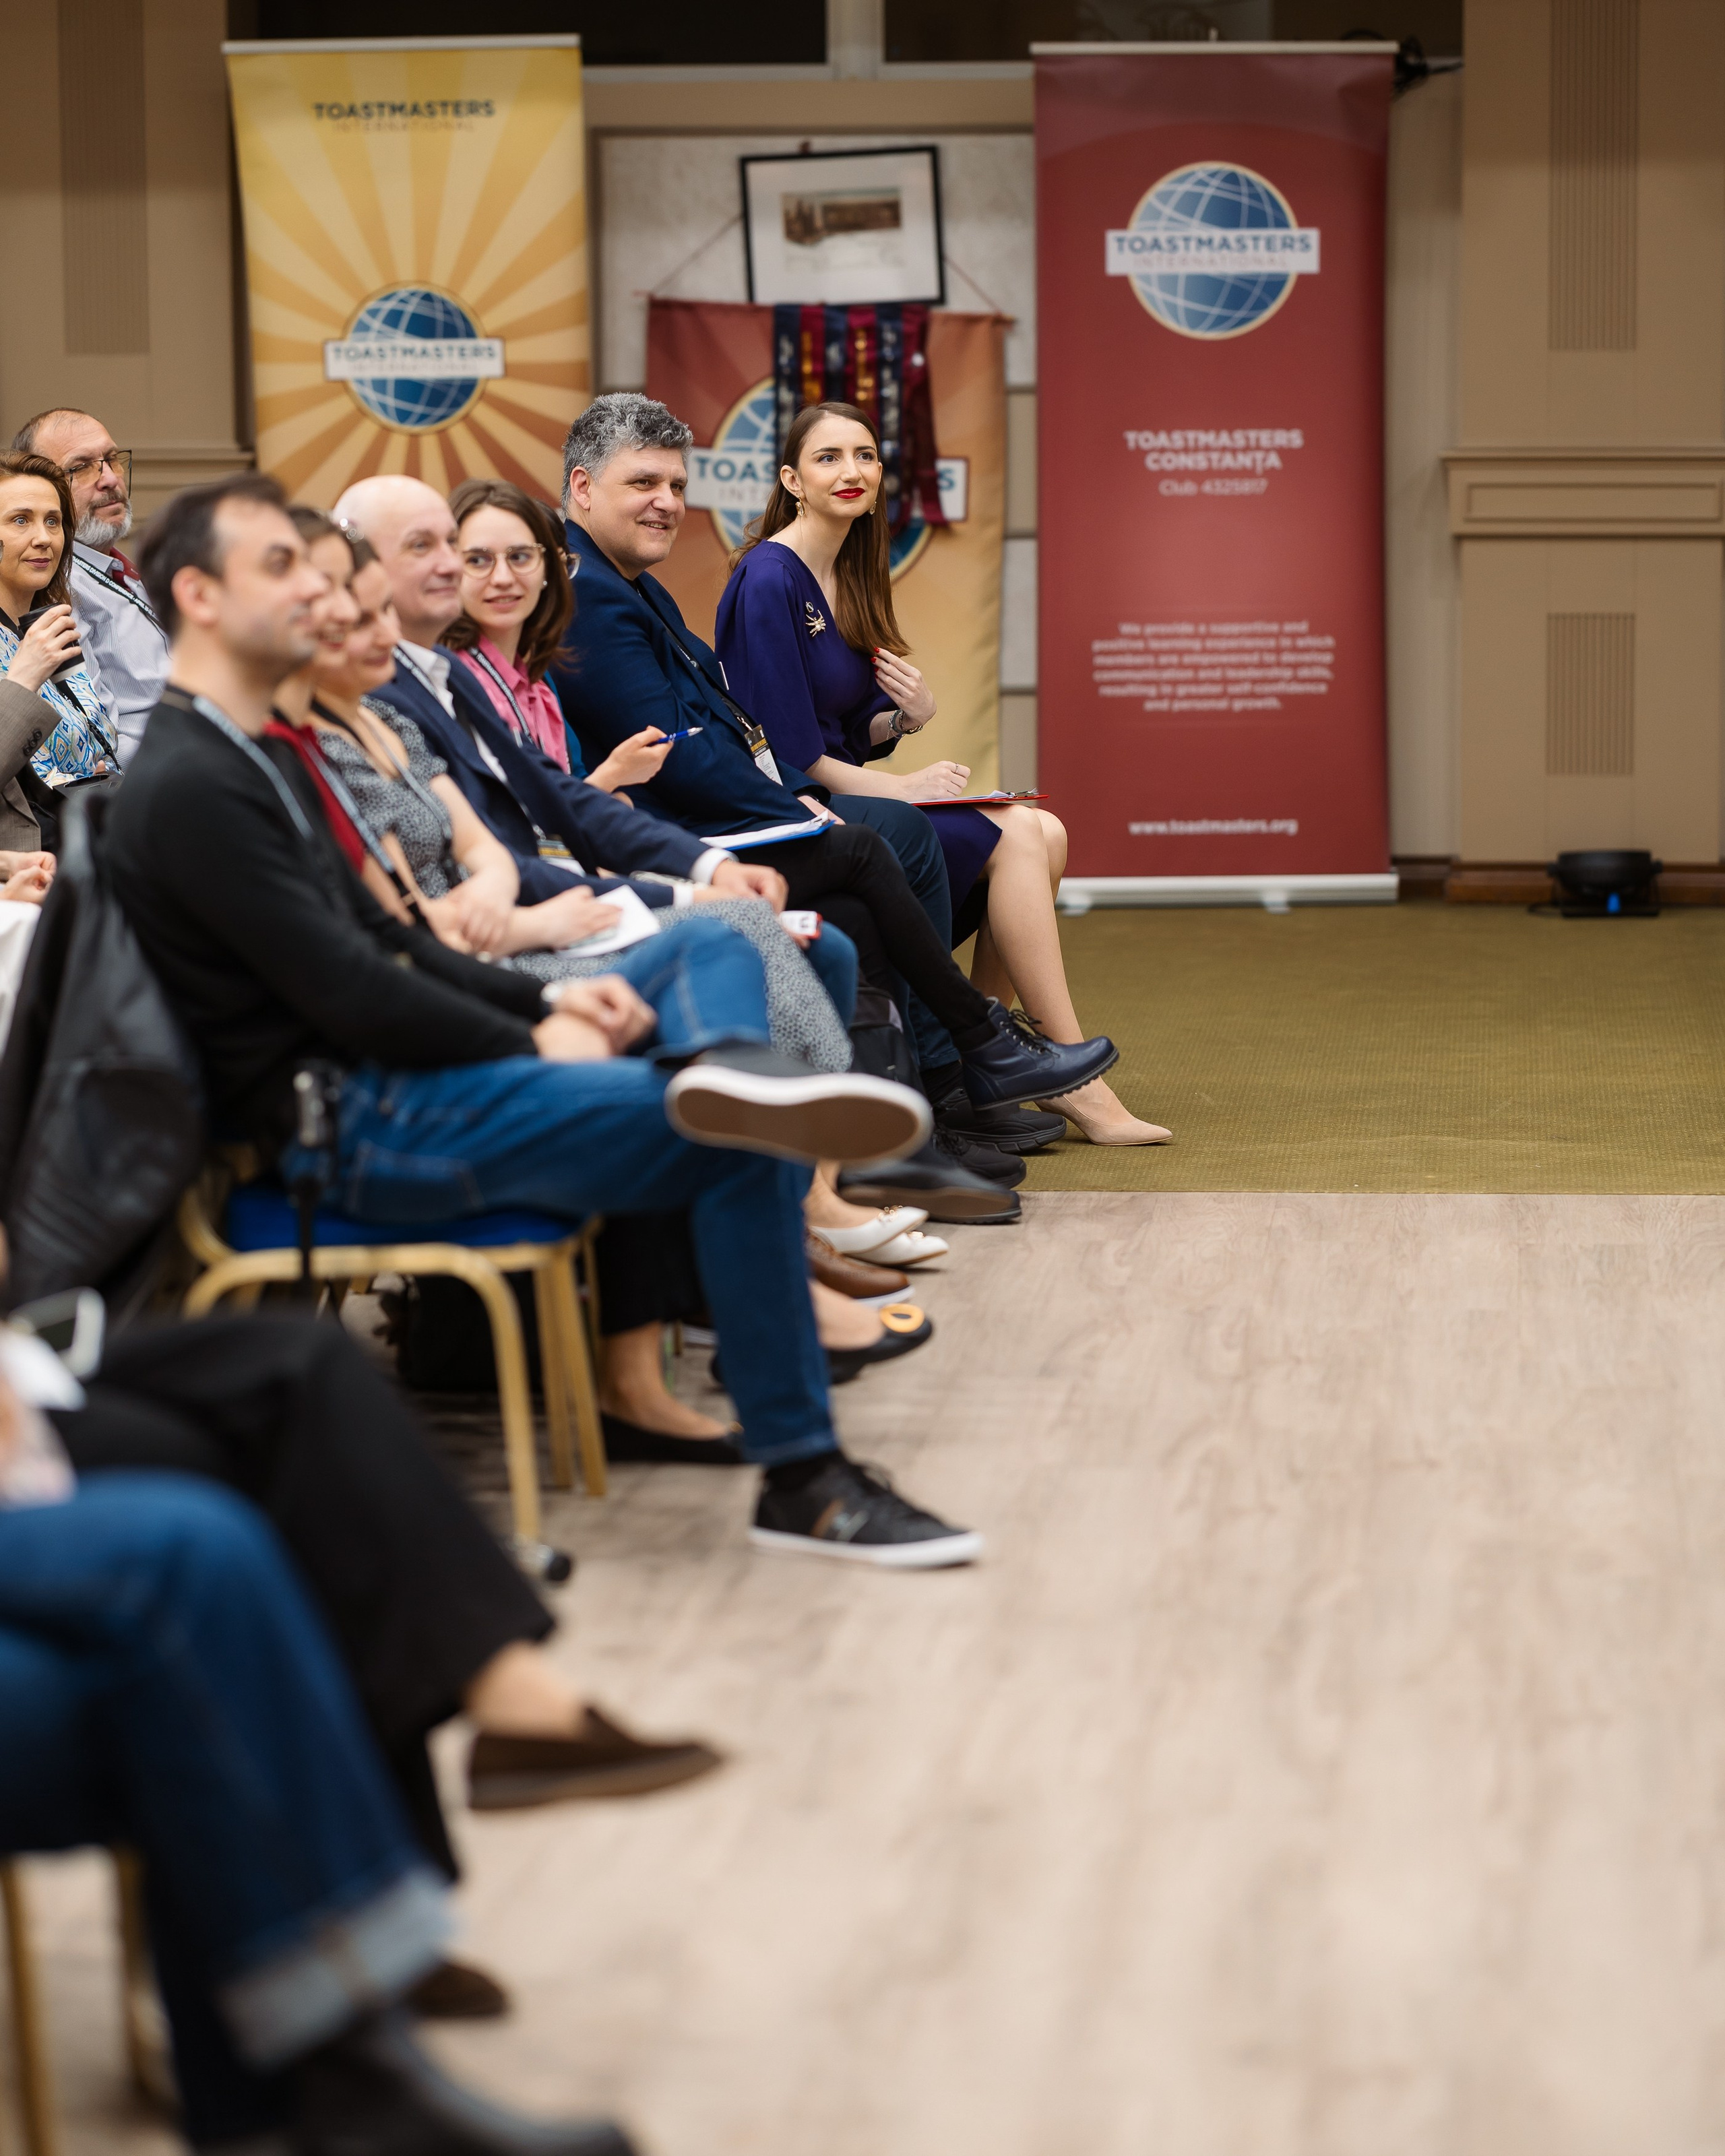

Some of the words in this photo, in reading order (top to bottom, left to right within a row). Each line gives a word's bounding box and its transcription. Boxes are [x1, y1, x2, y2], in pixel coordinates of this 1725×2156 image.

[313, 99, 495, 120] TOASTMASTERS
[1115, 234, 1312, 253] TOASTMASTERS
[334, 344, 496, 361] TOASTMASTERS
[1123, 429, 1304, 451] TOASTMASTERS
[1158, 478, 1198, 497] Club
[89, 567, 107, 581] DIVISION
[1282, 620, 1309, 634] and
[1295, 635, 1336, 649] which
[1127, 818, 1298, 837] www.toastmasters.org
